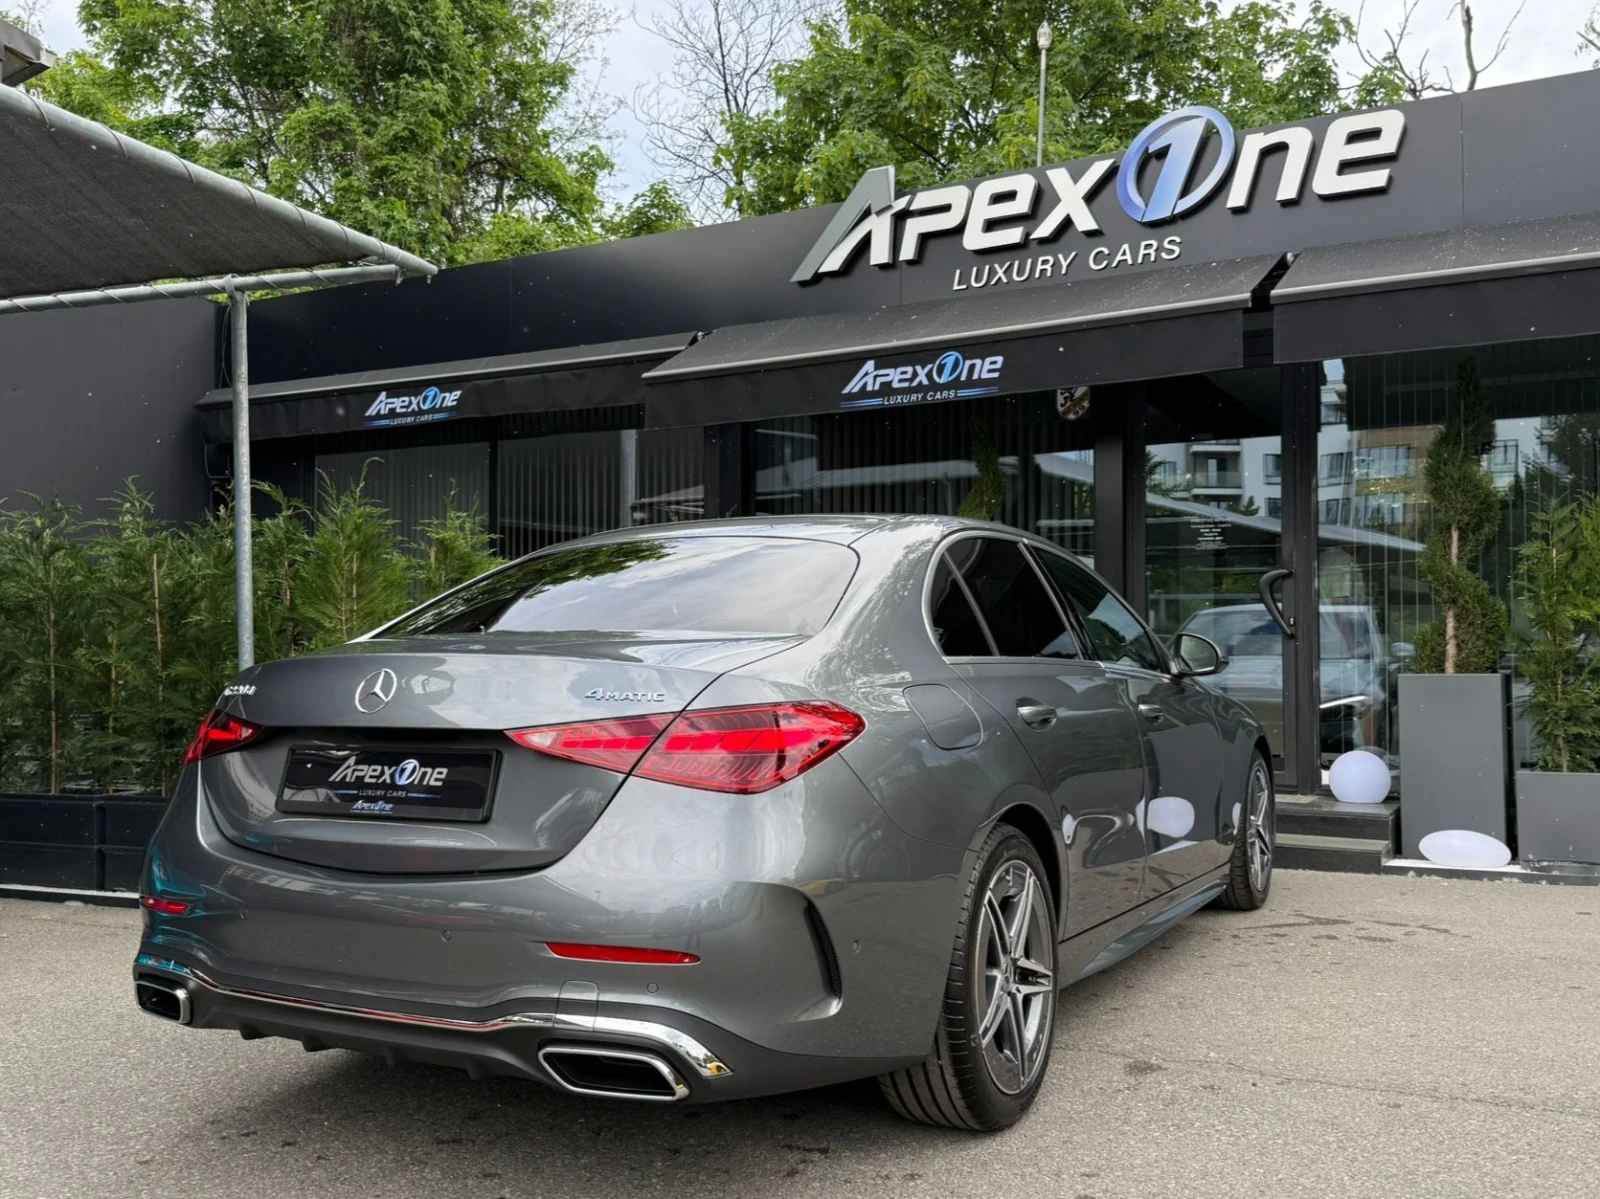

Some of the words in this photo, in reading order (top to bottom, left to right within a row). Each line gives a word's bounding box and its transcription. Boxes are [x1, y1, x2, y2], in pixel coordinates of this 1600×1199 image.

[951, 263, 1089, 292] LUXURY
[1087, 235, 1183, 272] CARS
[884, 393, 923, 405] LUXURY
[926, 389, 956, 400] CARS
[390, 416, 415, 425] LUXURY
[416, 413, 433, 422] CARS
[583, 687, 666, 702] 4MATIC
[359, 789, 385, 797] LUXURY
[387, 790, 406, 798] CARS
